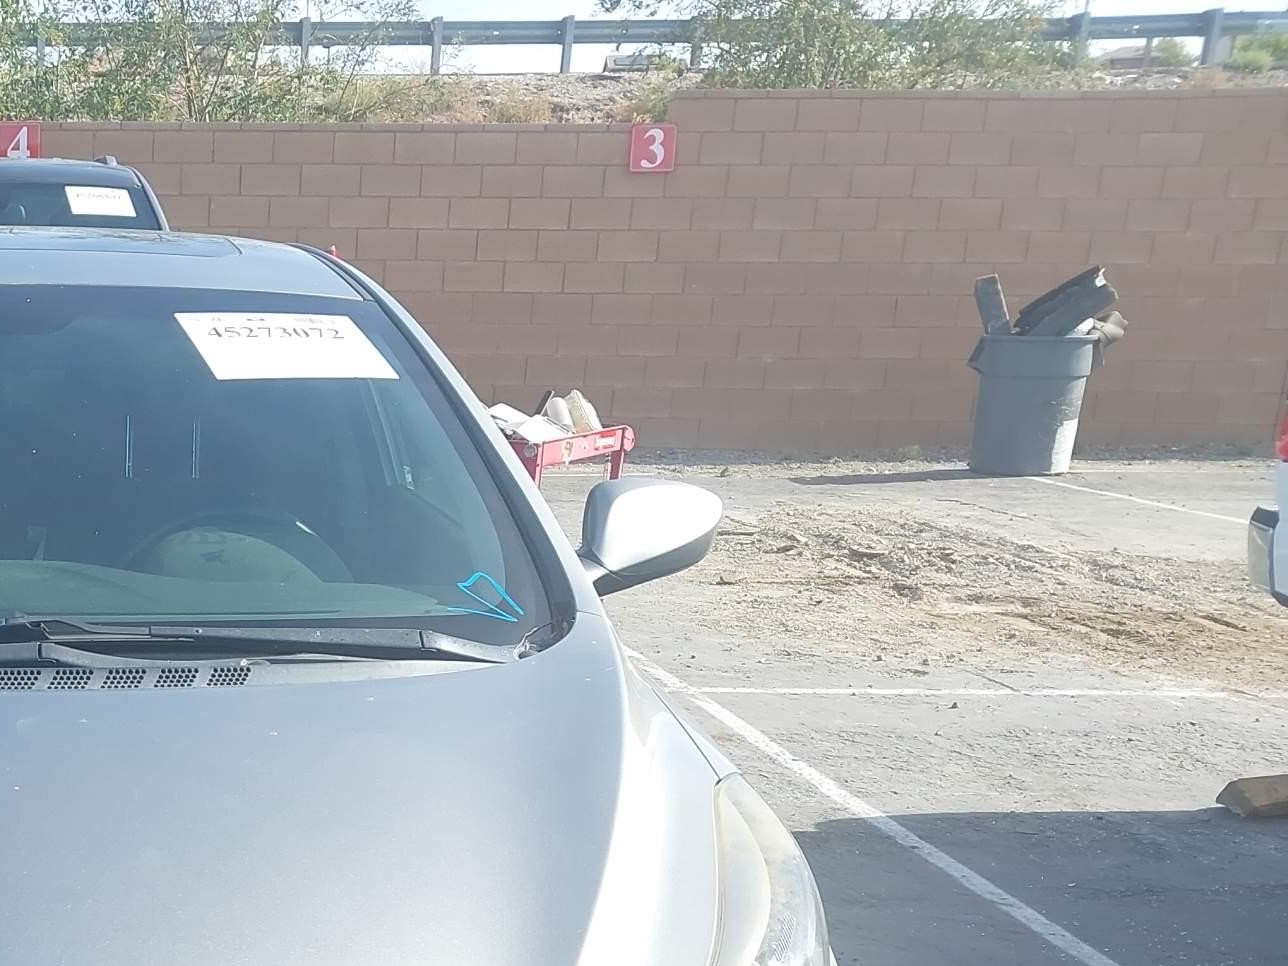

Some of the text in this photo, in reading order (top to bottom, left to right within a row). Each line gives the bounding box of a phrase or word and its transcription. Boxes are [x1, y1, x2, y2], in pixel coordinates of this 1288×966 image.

[7, 126, 31, 156] 4
[640, 128, 666, 168] 3
[207, 326, 345, 339] 45273072
